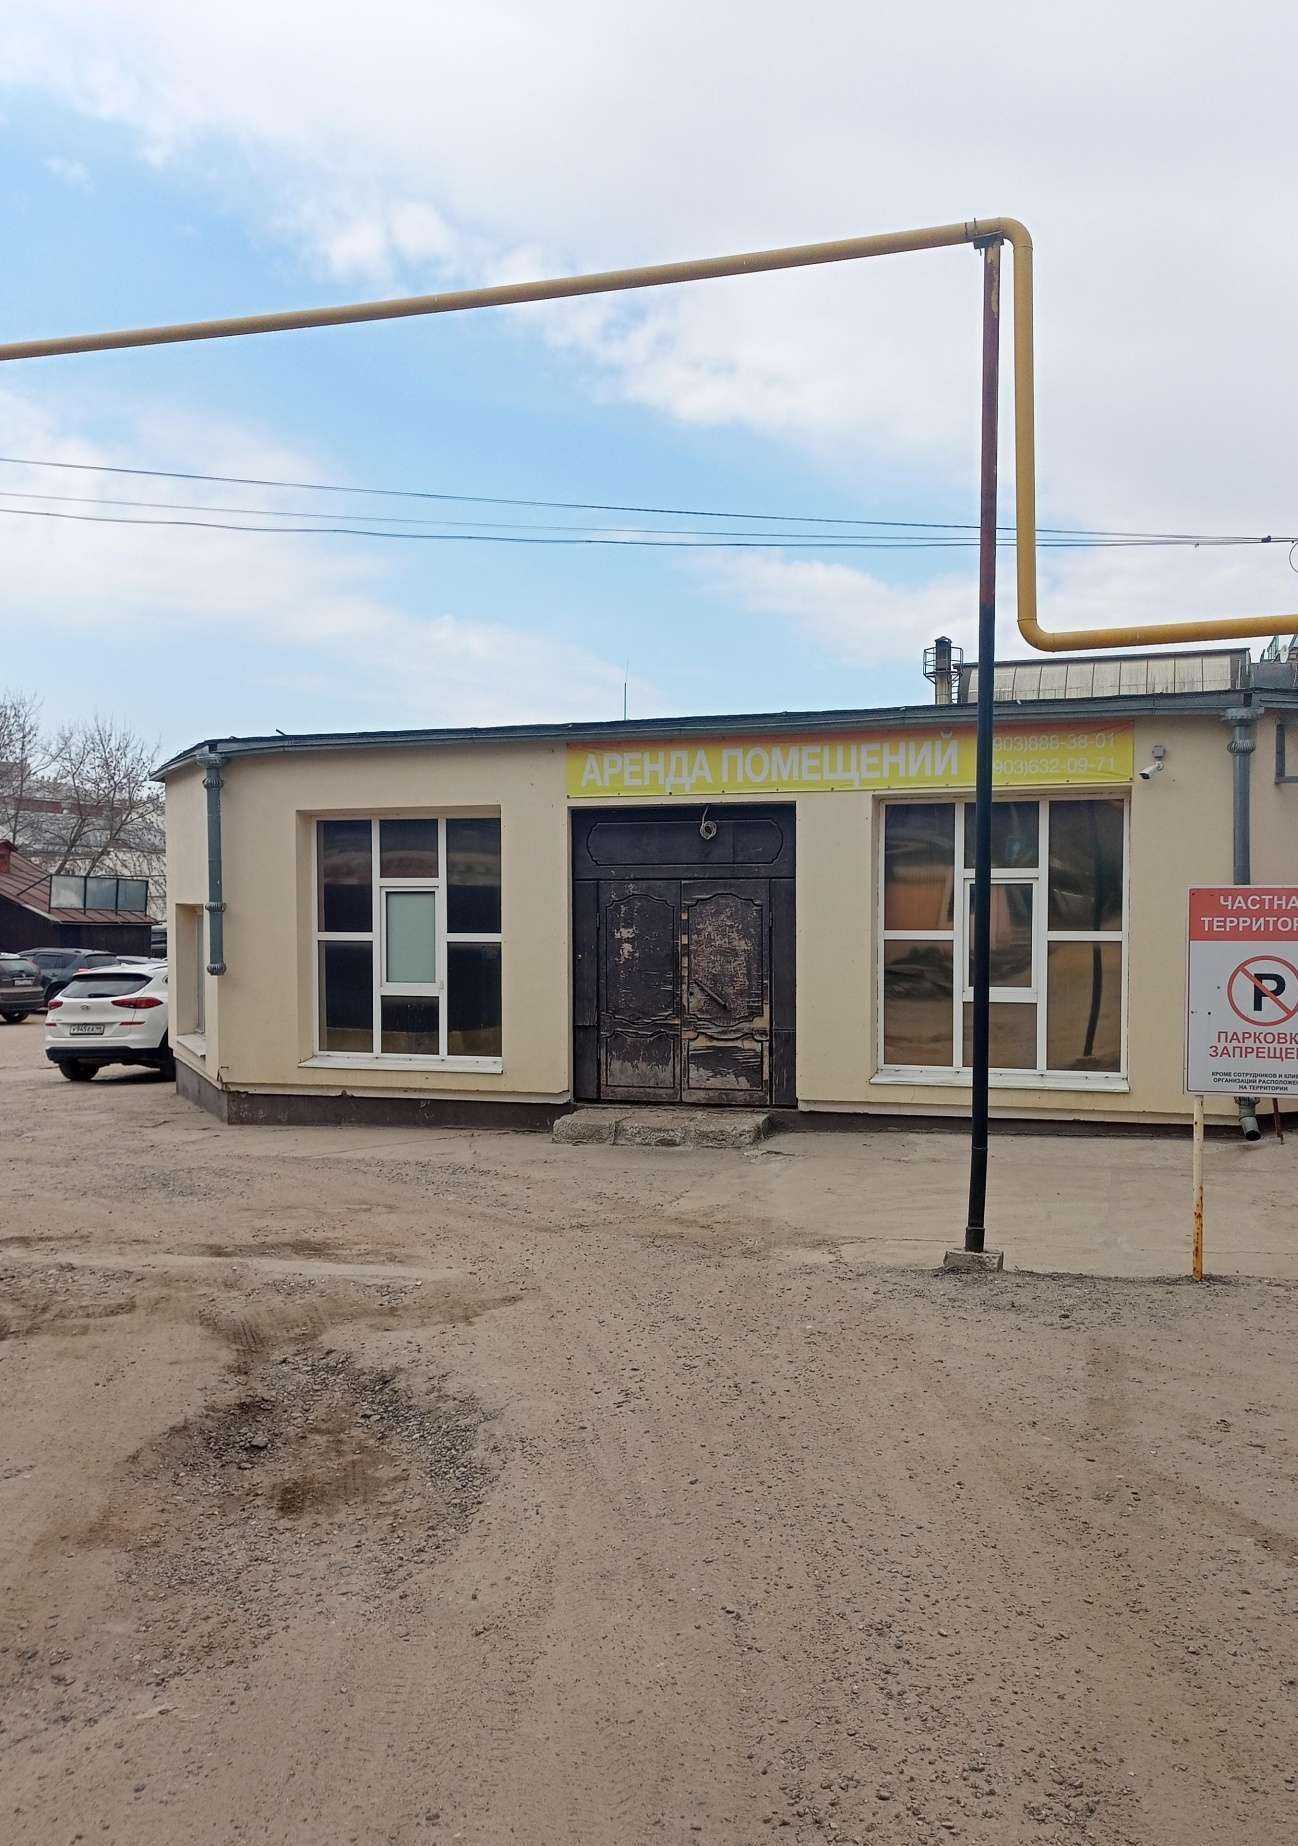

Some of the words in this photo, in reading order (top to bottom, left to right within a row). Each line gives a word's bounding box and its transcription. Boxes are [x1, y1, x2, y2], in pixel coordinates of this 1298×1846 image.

[581, 752, 713, 791] АРЕНДА
[721, 729, 958, 787] ПОМЕЩЕНИЙ
[1217, 1031, 1298, 1045] ПАРКОВК
[1209, 1045, 1298, 1062] ЗАПРЕЩЕ
